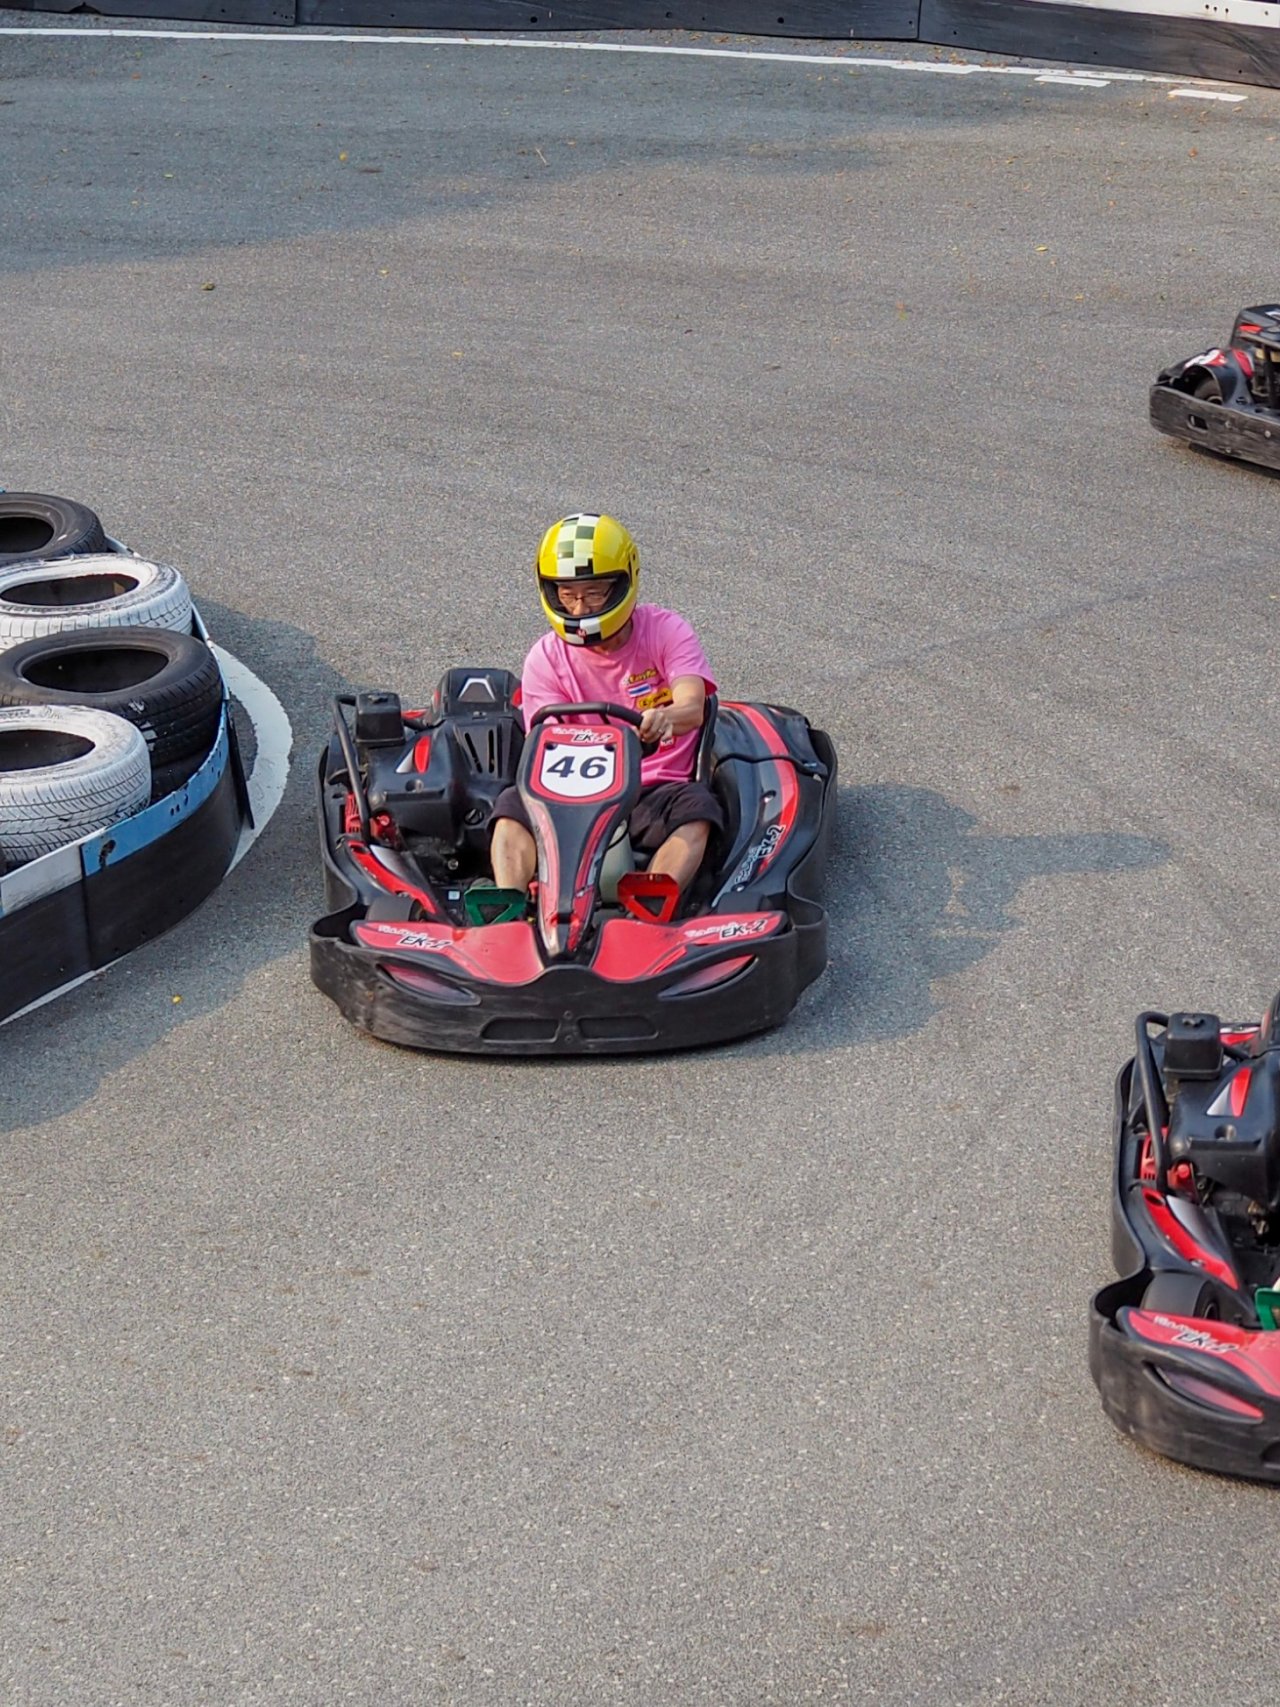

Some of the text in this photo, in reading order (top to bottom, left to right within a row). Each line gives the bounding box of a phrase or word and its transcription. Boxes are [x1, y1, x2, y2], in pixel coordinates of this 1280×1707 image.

[546, 755, 608, 779] 46
[757, 825, 787, 859] EK-2
[721, 919, 768, 939] EK-2
